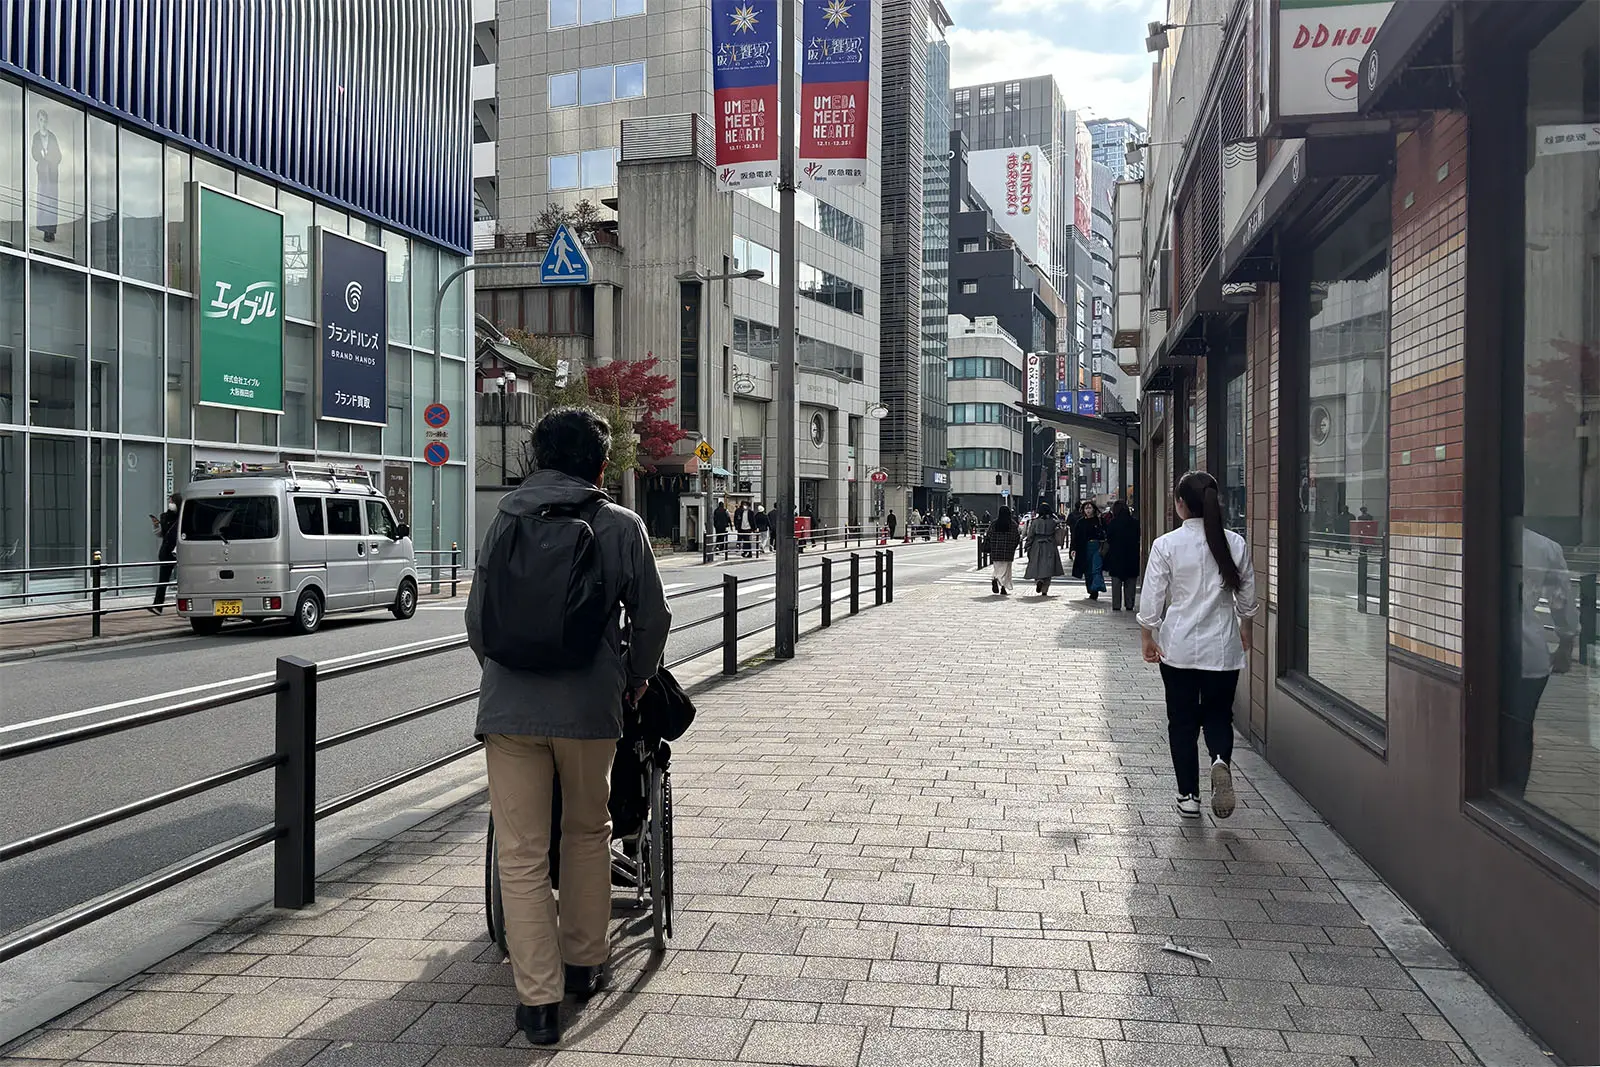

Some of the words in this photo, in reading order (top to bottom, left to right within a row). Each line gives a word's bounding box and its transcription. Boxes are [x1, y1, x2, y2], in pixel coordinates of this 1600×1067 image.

[724, 98, 765, 115] UMEDA
[814, 94, 855, 110] UMEDA
[725, 111, 765, 129] MEETS
[814, 109, 855, 124] MEETS
[740, 170, 773, 180] 阪急電鉄
[828, 168, 862, 177] 阪急電鉄
[1006, 152, 1019, 216] まねきねこ
[1021, 162, 1033, 206] カラオケ
[203, 281, 277, 325] エイブル
[327, 322, 379, 350] ブランドハンズ
[331, 349, 353, 361] BRAND
[355, 355, 376, 366] HANDS
[223, 374, 261, 387] 株式会社エイブル
[335, 390, 371, 409] ブランド買取
[220, 605, 241, 614] 32-53
